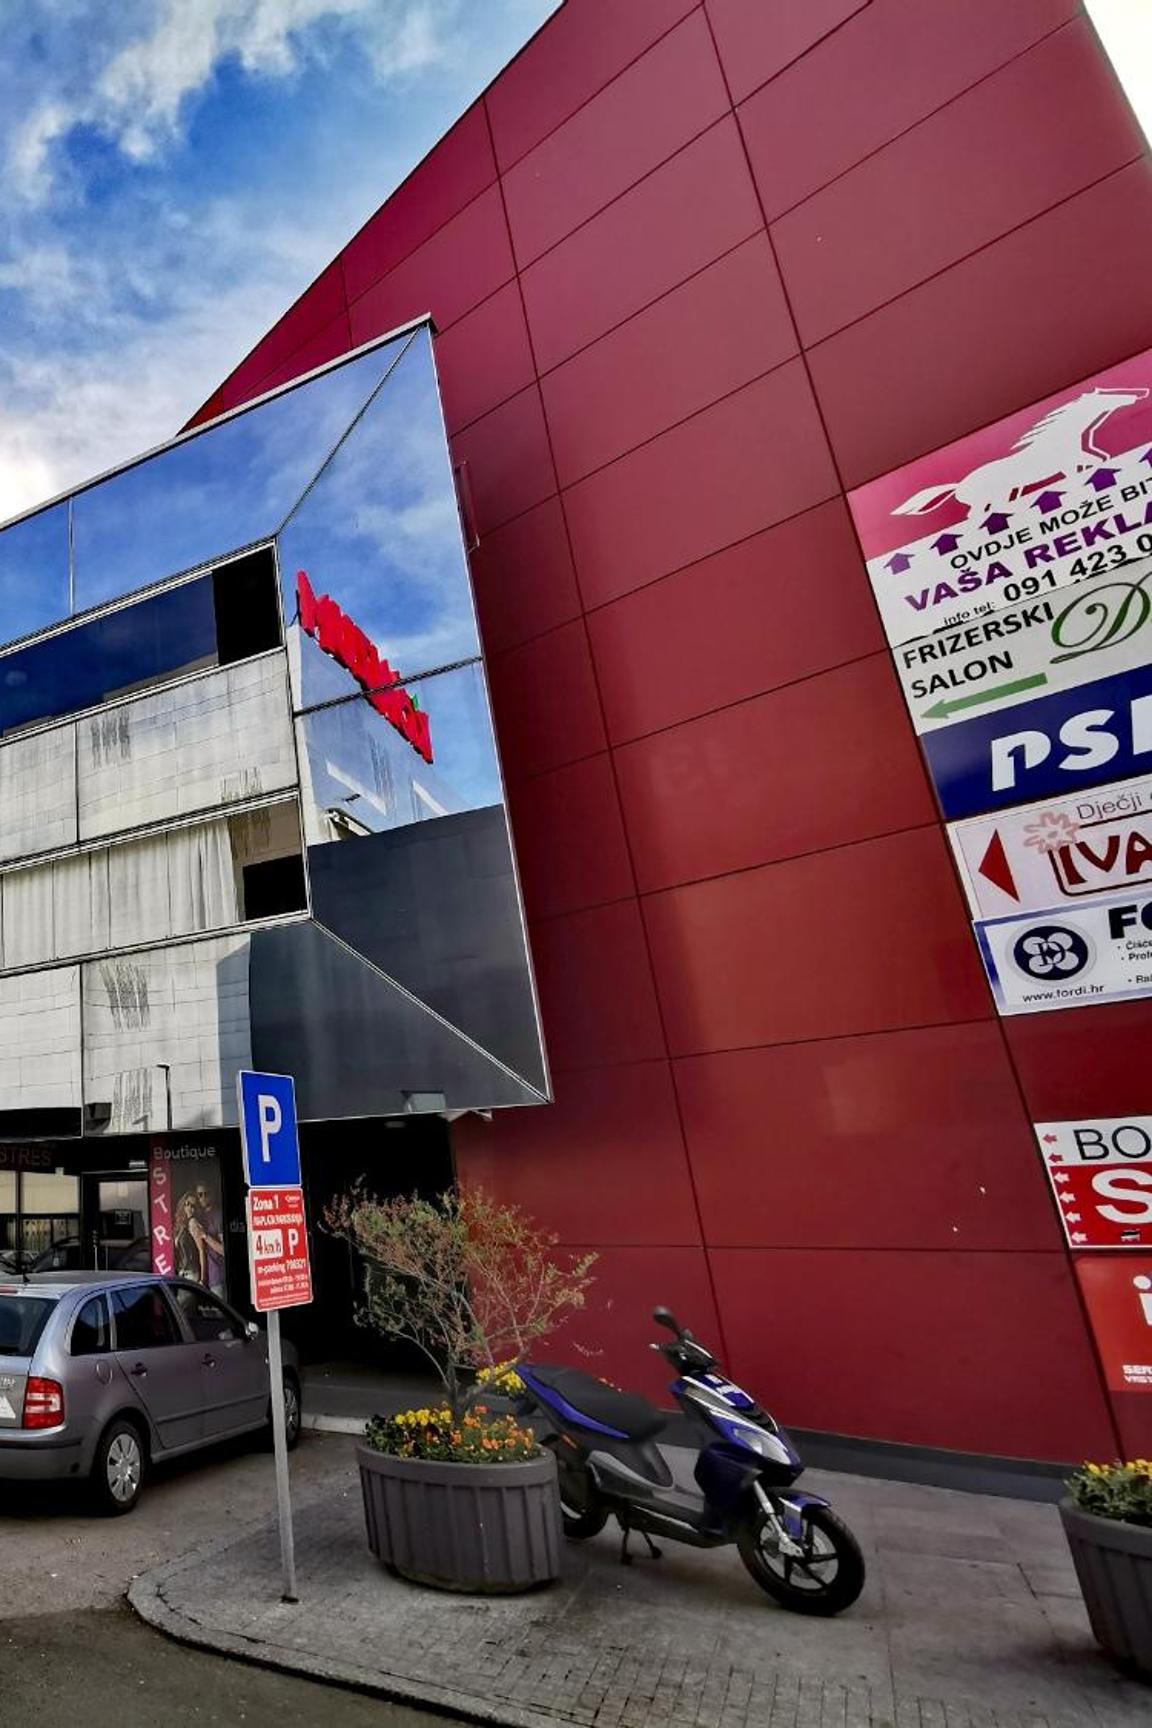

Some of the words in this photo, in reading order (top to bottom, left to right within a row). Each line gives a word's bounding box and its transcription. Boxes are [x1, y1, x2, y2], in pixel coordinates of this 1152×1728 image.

[951, 528, 1033, 571] OVDJE
[1039, 495, 1113, 537] MOŽE
[904, 561, 1014, 613] VAŠA
[944, 611, 971, 625] info
[1004, 569, 1057, 602] 091
[1070, 544, 1128, 578] 423
[902, 601, 1055, 669] FRIZERSKI
[912, 651, 1014, 699] SALON
[1077, 793, 1143, 820] Dječji
[1022, 982, 1105, 1003] www.fordi.hr
[153, 1144, 217, 1161] Boutique
[257, 1094, 283, 1163] P
[288, 1229, 299, 1256] P
